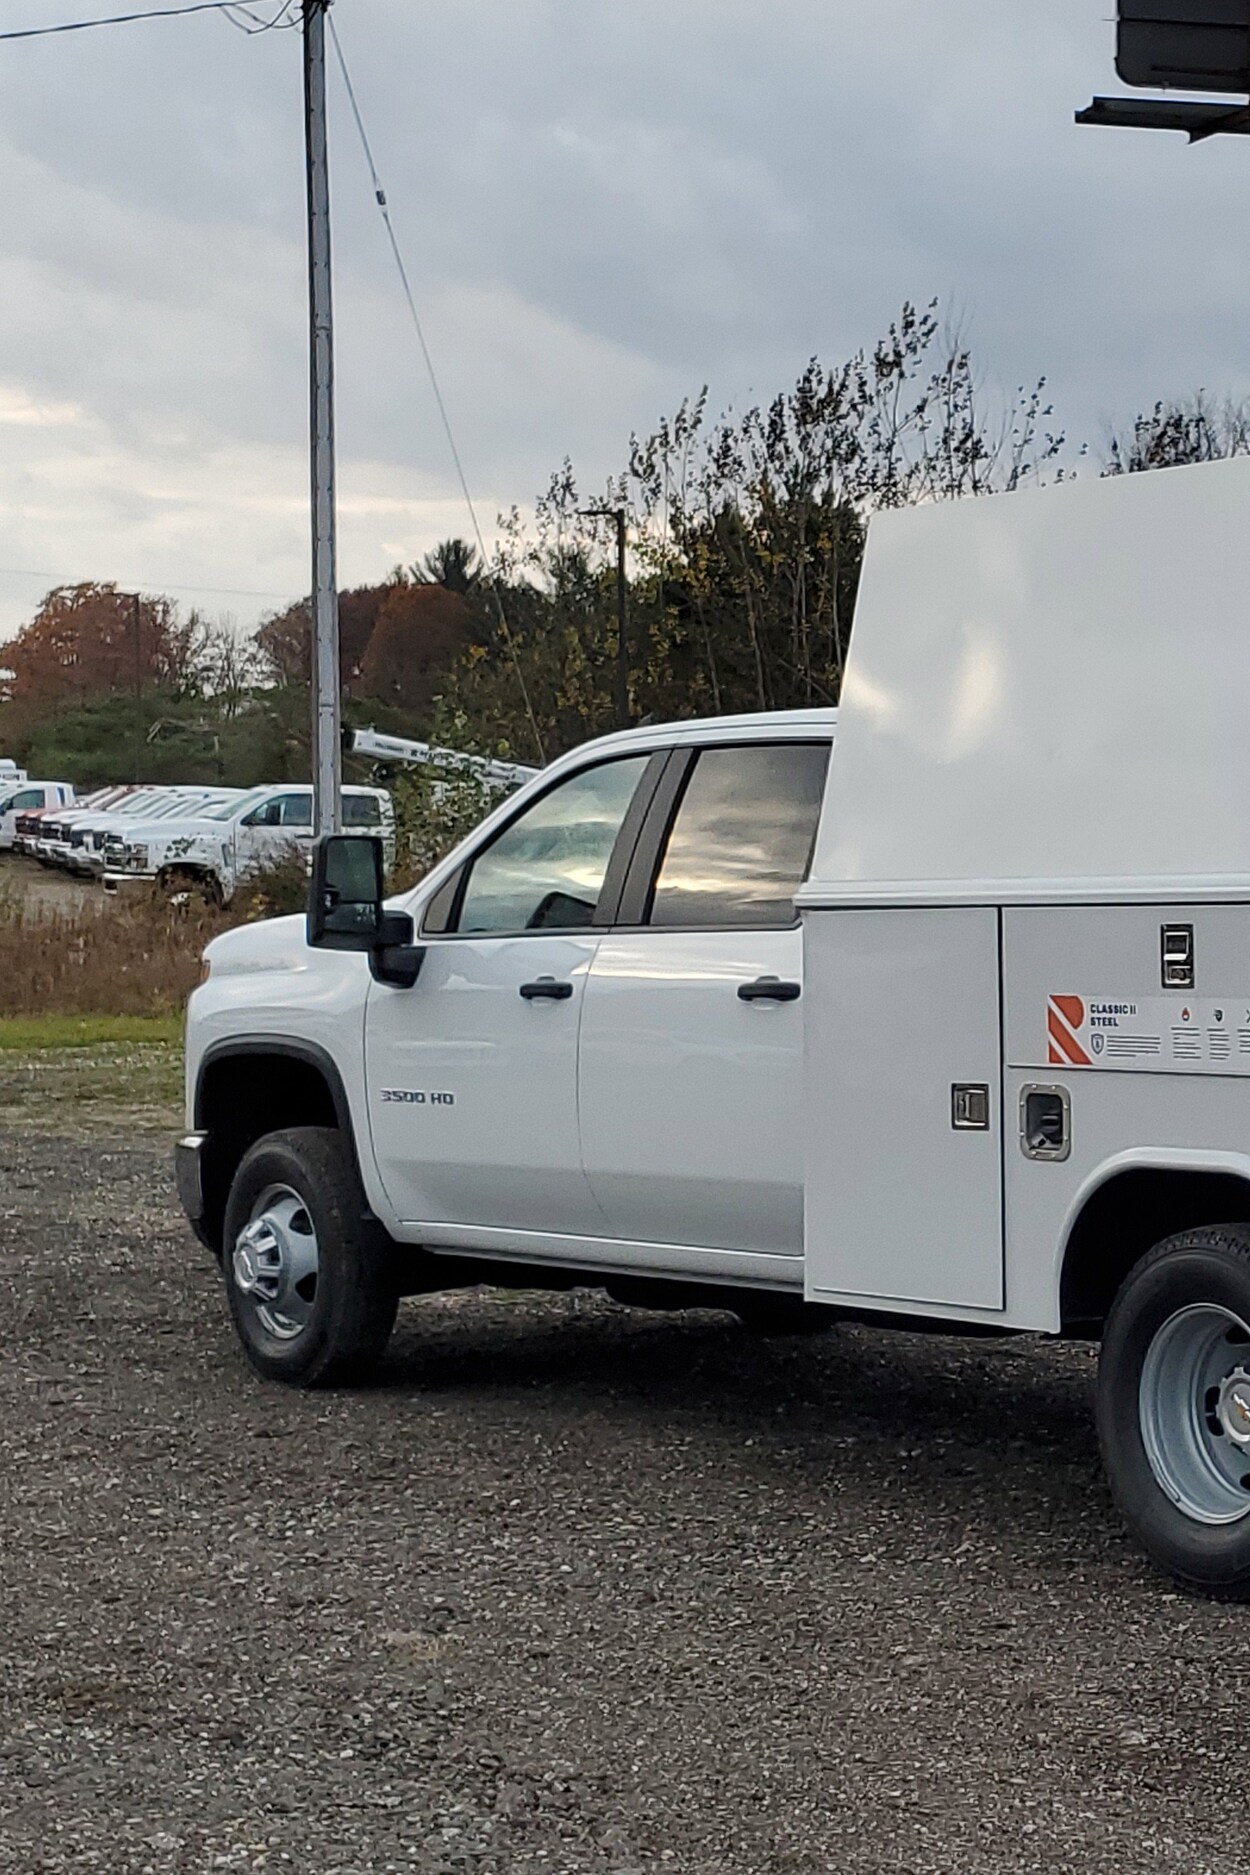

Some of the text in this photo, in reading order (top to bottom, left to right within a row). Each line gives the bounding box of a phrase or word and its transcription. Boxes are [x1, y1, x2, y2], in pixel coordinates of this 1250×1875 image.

[1090, 1004, 1128, 1015] CLASSIC
[1090, 1017, 1119, 1027] STEEL
[380, 1090, 454, 1105] 3500 HD
